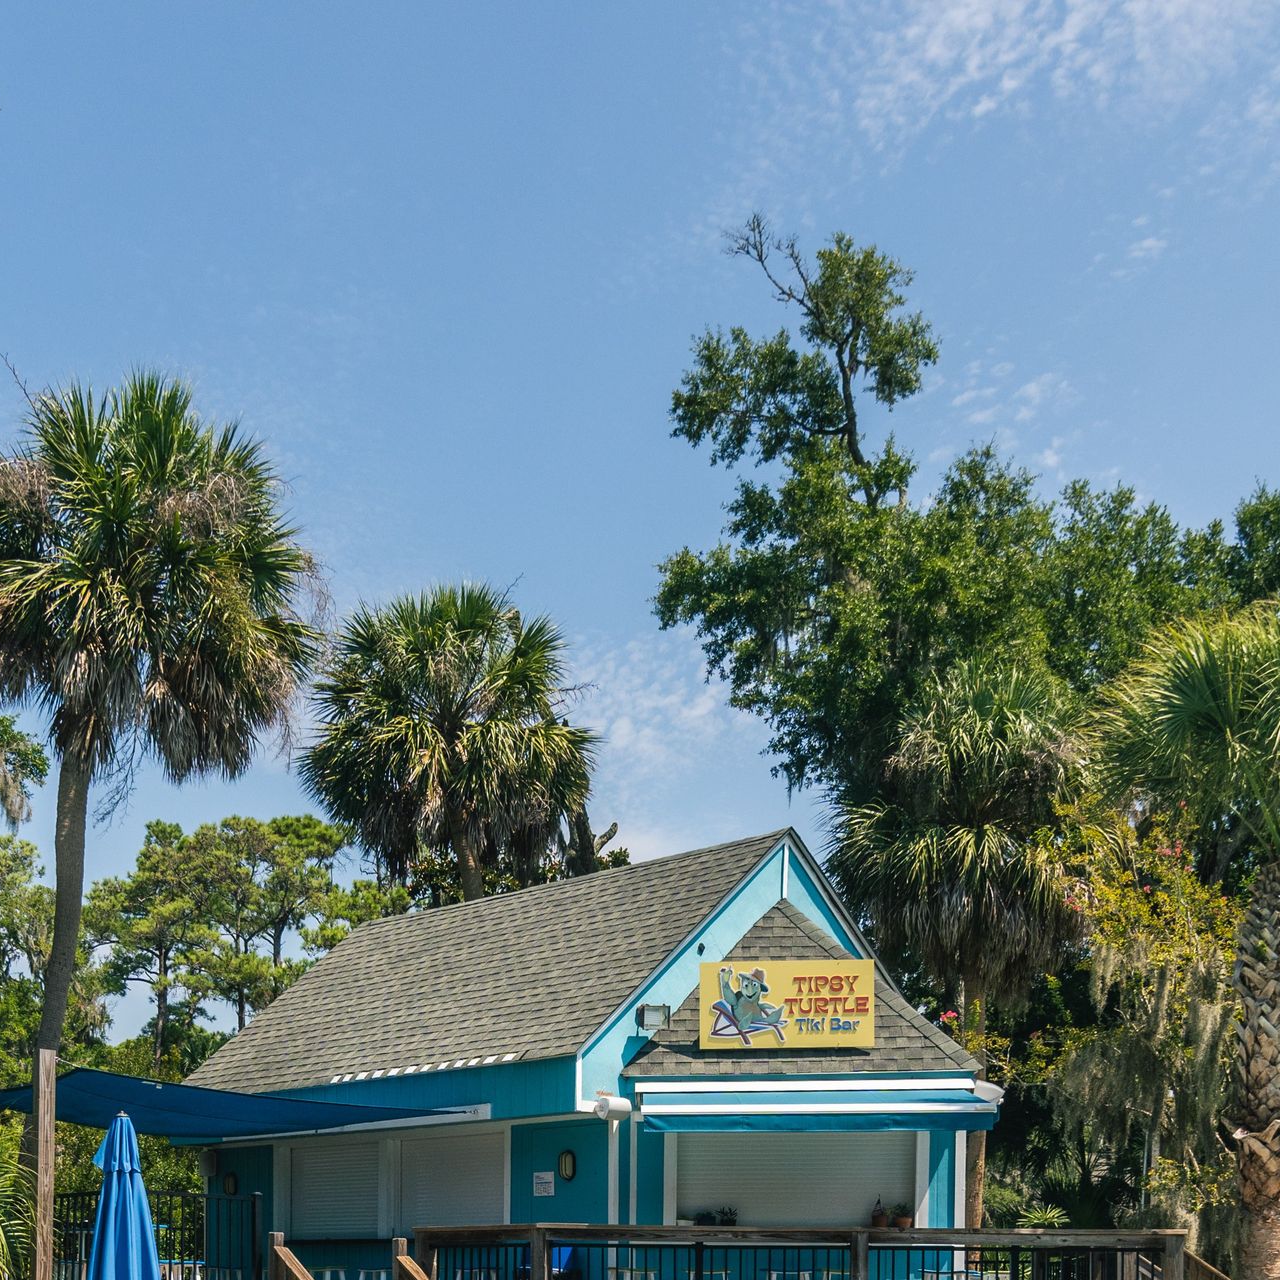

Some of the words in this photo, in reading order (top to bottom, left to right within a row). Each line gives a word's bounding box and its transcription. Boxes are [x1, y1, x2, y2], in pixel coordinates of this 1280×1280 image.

[792, 975, 859, 994] TIPSY
[784, 996, 870, 1015] TURTLE
[795, 1017, 825, 1033] Tiki
[830, 1017, 860, 1032] Bar
